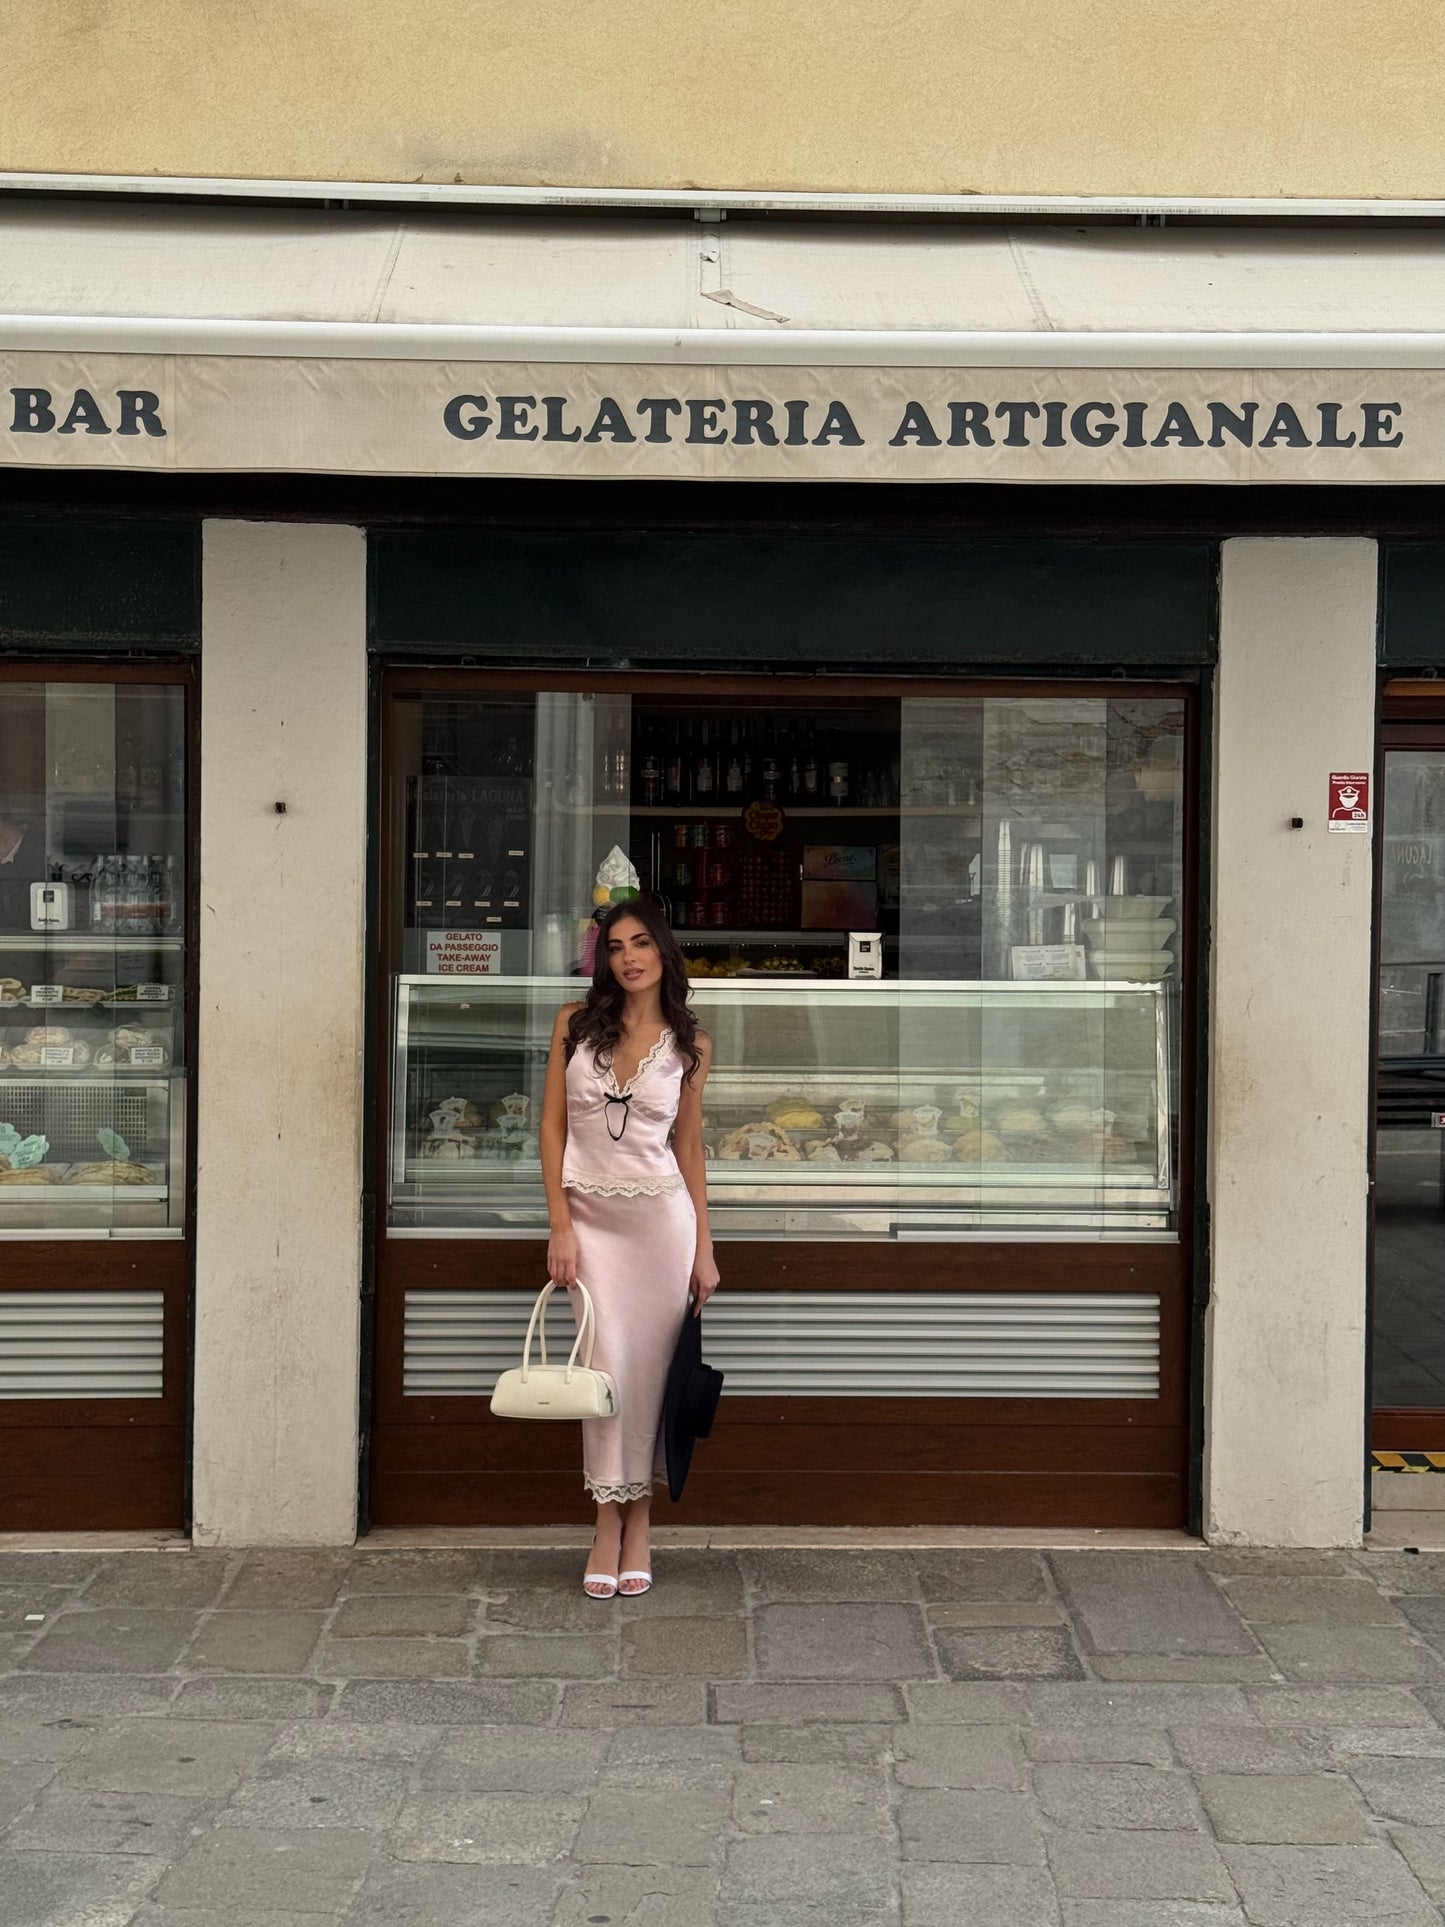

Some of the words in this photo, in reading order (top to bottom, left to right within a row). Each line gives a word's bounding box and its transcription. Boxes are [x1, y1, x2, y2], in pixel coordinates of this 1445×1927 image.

[10, 388, 166, 436] BAR
[444, 395, 865, 446] GELATERIA
[889, 401, 1403, 448] ARTIGIANALE
[472, 788, 523, 801] LAGUNA
[445, 943, 498, 951] PASSEGGIO
[437, 953, 491, 961] TAKE-AWAY
[438, 964, 454, 972] ICE
[456, 964, 489, 972] CREAM
